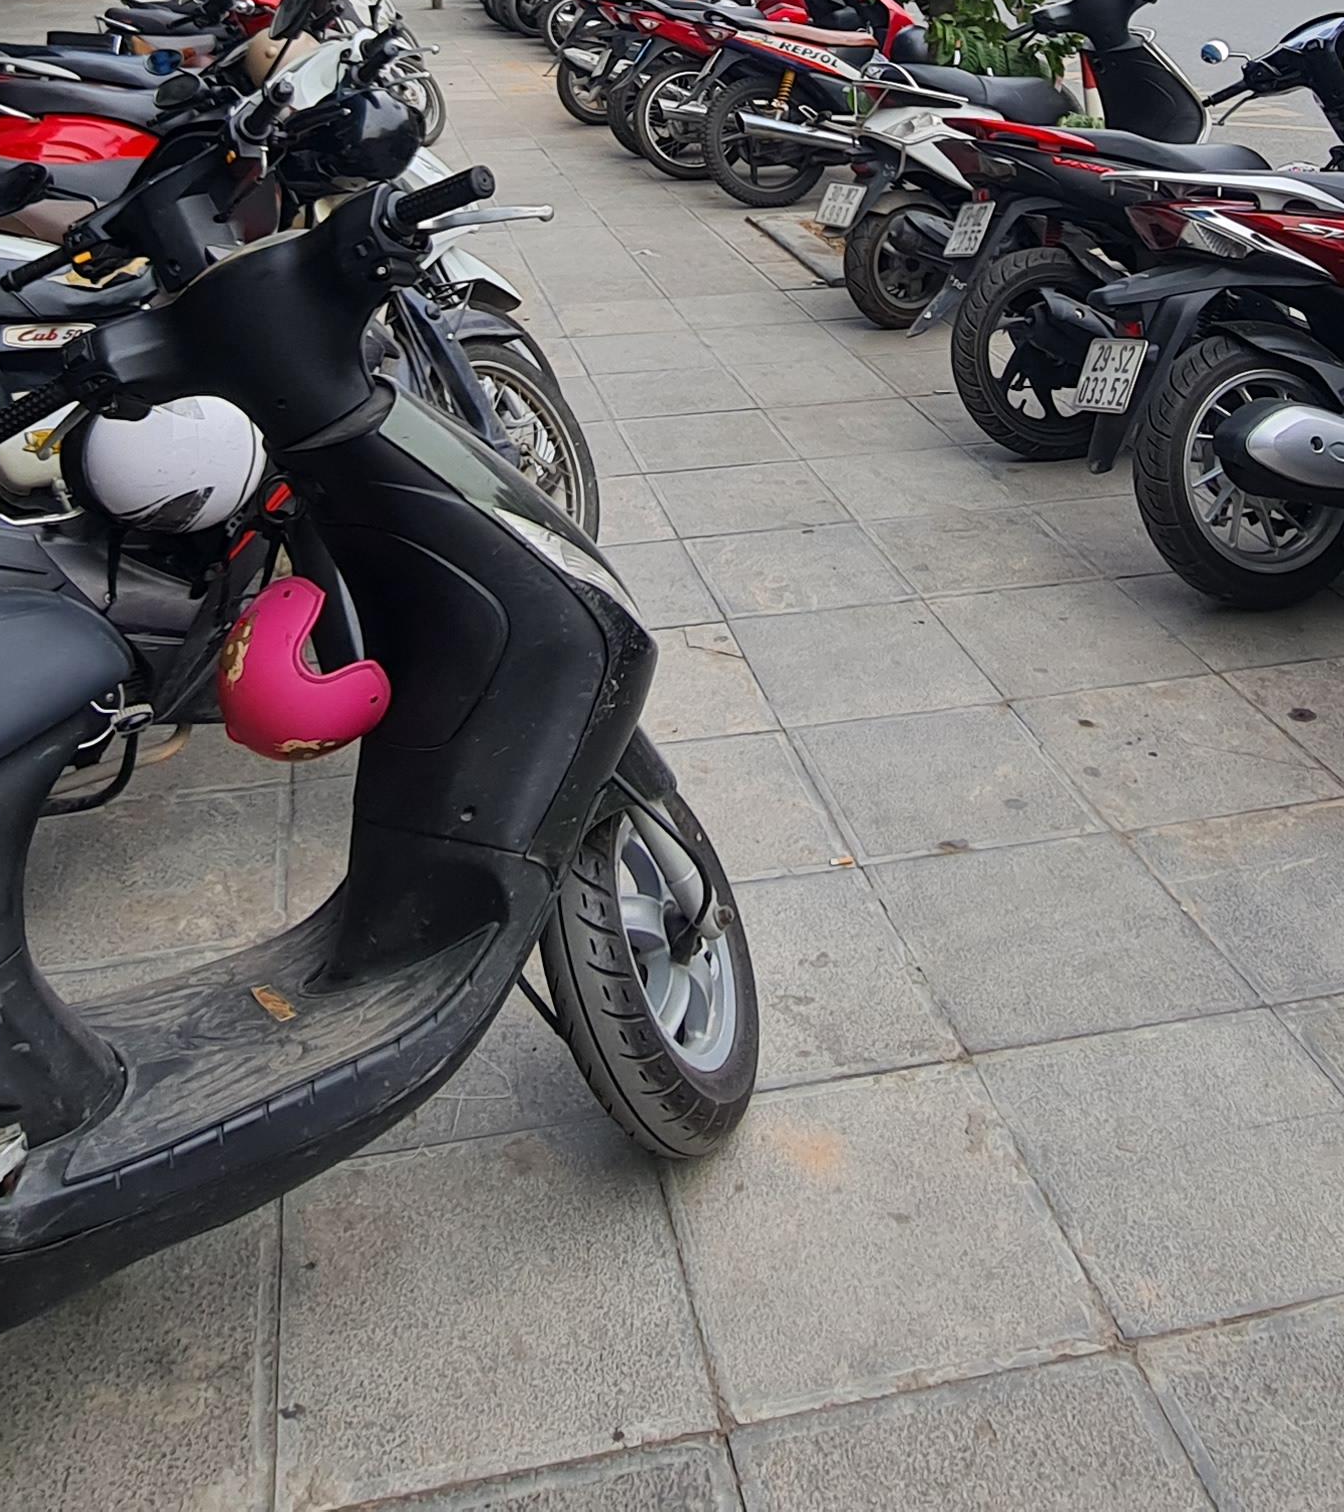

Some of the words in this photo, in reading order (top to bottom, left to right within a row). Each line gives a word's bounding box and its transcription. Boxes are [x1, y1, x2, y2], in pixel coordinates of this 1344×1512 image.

[779, 41, 839, 68] REPSOL
[17, 328, 58, 342] Cub
[62, 329, 84, 340] 50
[1091, 345, 1136, 373] 29-S2
[1078, 376, 1130, 407] 033.52
